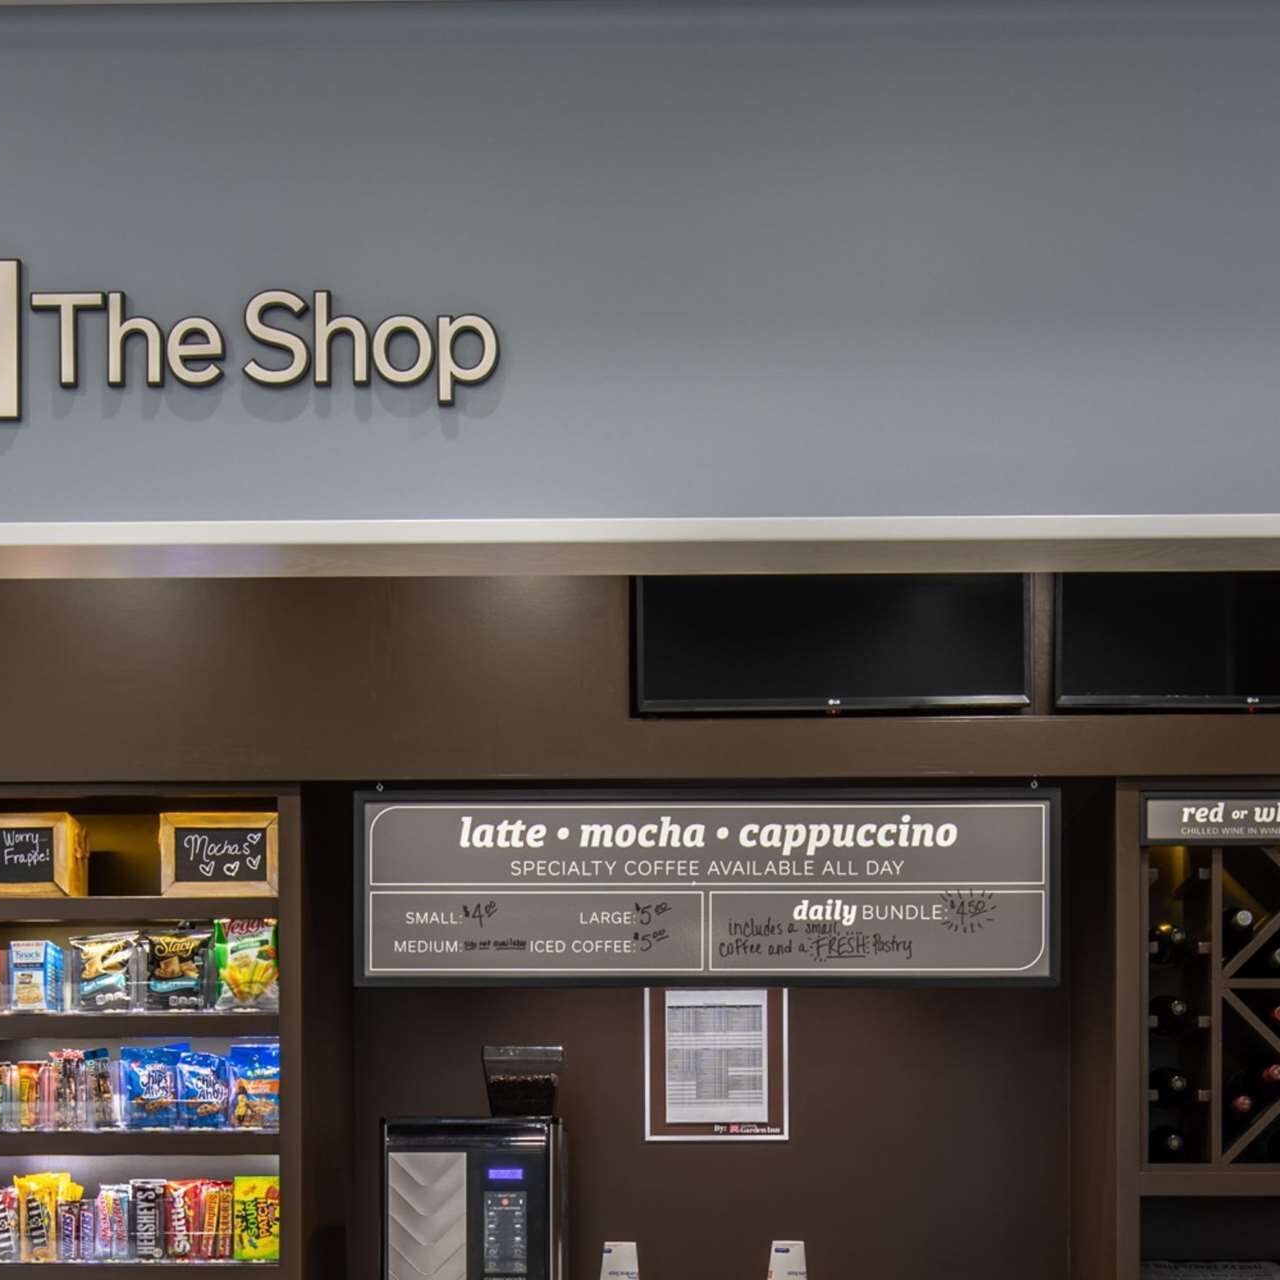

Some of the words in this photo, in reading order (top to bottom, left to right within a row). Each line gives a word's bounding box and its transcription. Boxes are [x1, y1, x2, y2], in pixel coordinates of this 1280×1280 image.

[30, 291, 225, 388] The
[242, 289, 500, 405] Shop
[1181, 802, 1224, 823] red
[1232, 809, 1248, 820] or
[459, 815, 546, 848] latte
[579, 817, 705, 848] mocha
[738, 815, 958, 856] cappuccino
[1181, 827, 1219, 835] CHILLED
[1222, 827, 1245, 835] WINE
[1248, 827, 1257, 835] IN
[511, 860, 617, 877] SPECIALTY
[624, 860, 700, 876] COFFEE
[707, 860, 815, 876] AVAILABLE
[822, 860, 859, 876] ALL
[866, 860, 904, 876] DAY
[406, 912, 463, 925] SMALL:
[580, 912, 636, 925] LARGE:
[793, 899, 857, 926] daily
[862, 904, 948, 920] BUNDLE:
[729, 919, 783, 937] includes
[394, 940, 463, 953] MEDIUM:
[530, 940, 566, 953] ICED
[572, 940, 636, 953] COFFEE:
[768, 937, 793, 954] and
[815, 935, 867, 957] FRESH
